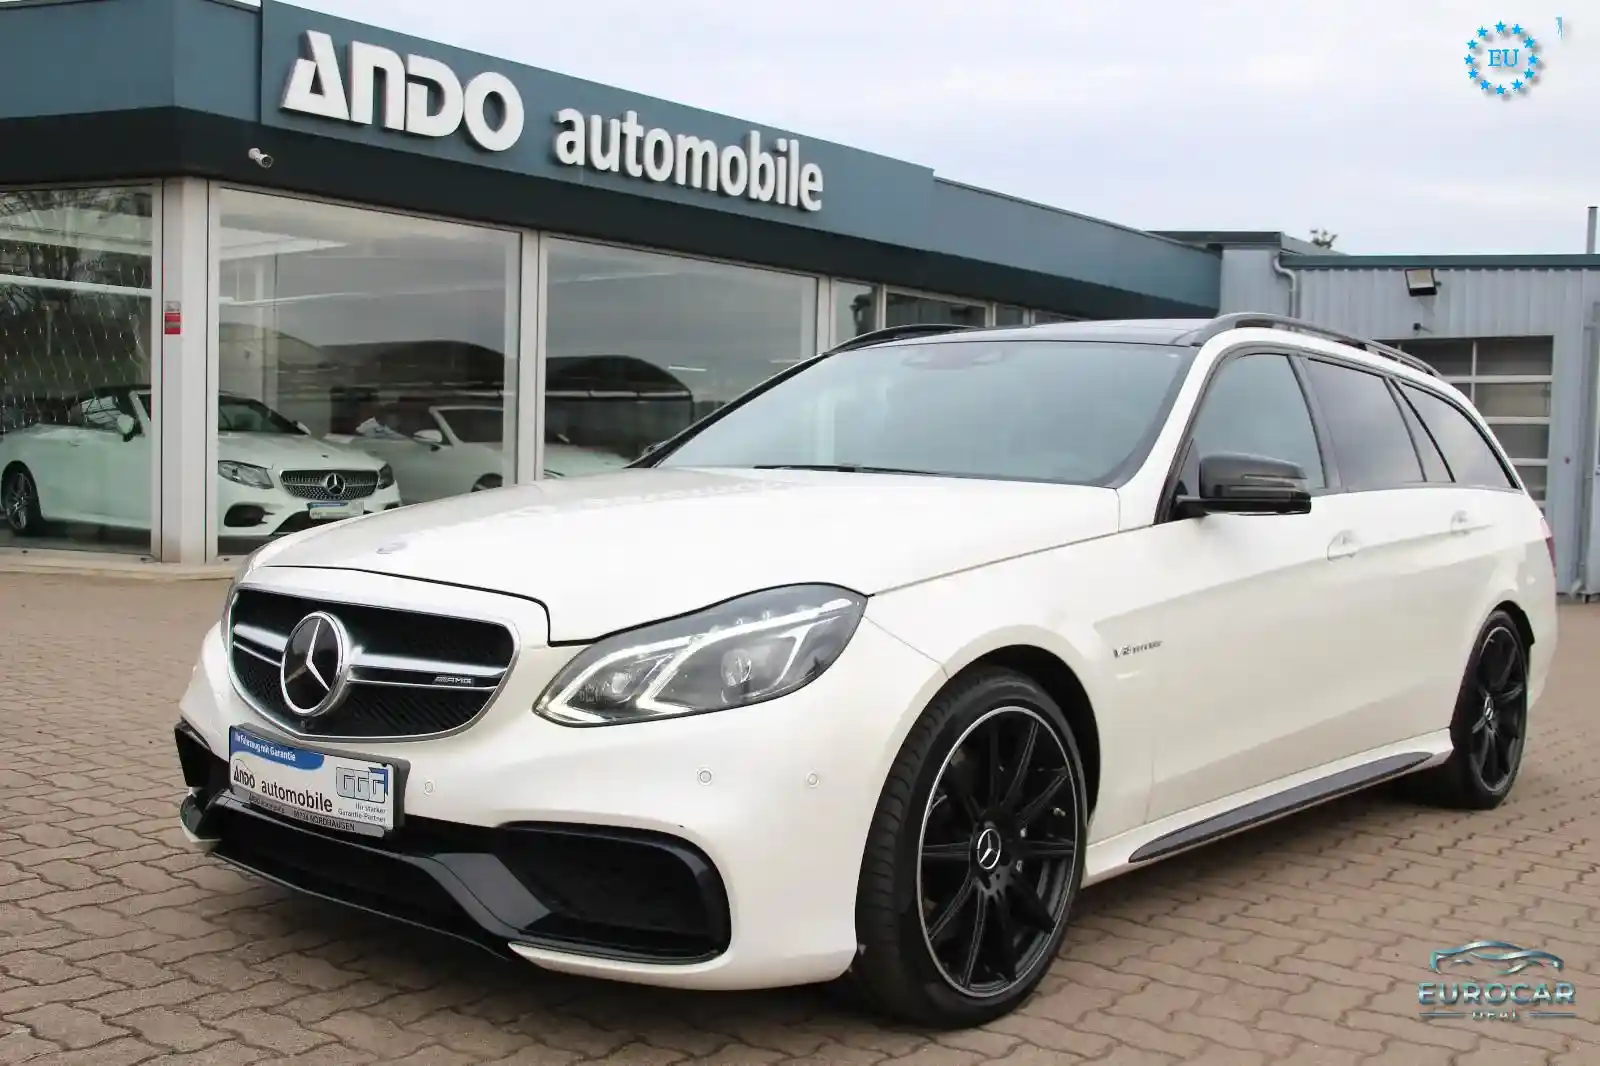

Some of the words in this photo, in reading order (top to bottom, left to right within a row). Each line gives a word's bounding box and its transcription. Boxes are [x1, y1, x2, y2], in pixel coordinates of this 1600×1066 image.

[280, 29, 525, 152] ANDO
[552, 107, 823, 212] automobile
[270, 746, 296, 762] Garantie
[233, 765, 256, 789] ANDO
[261, 780, 333, 813] automobile
[309, 813, 355, 832] NORDHAUSEN
